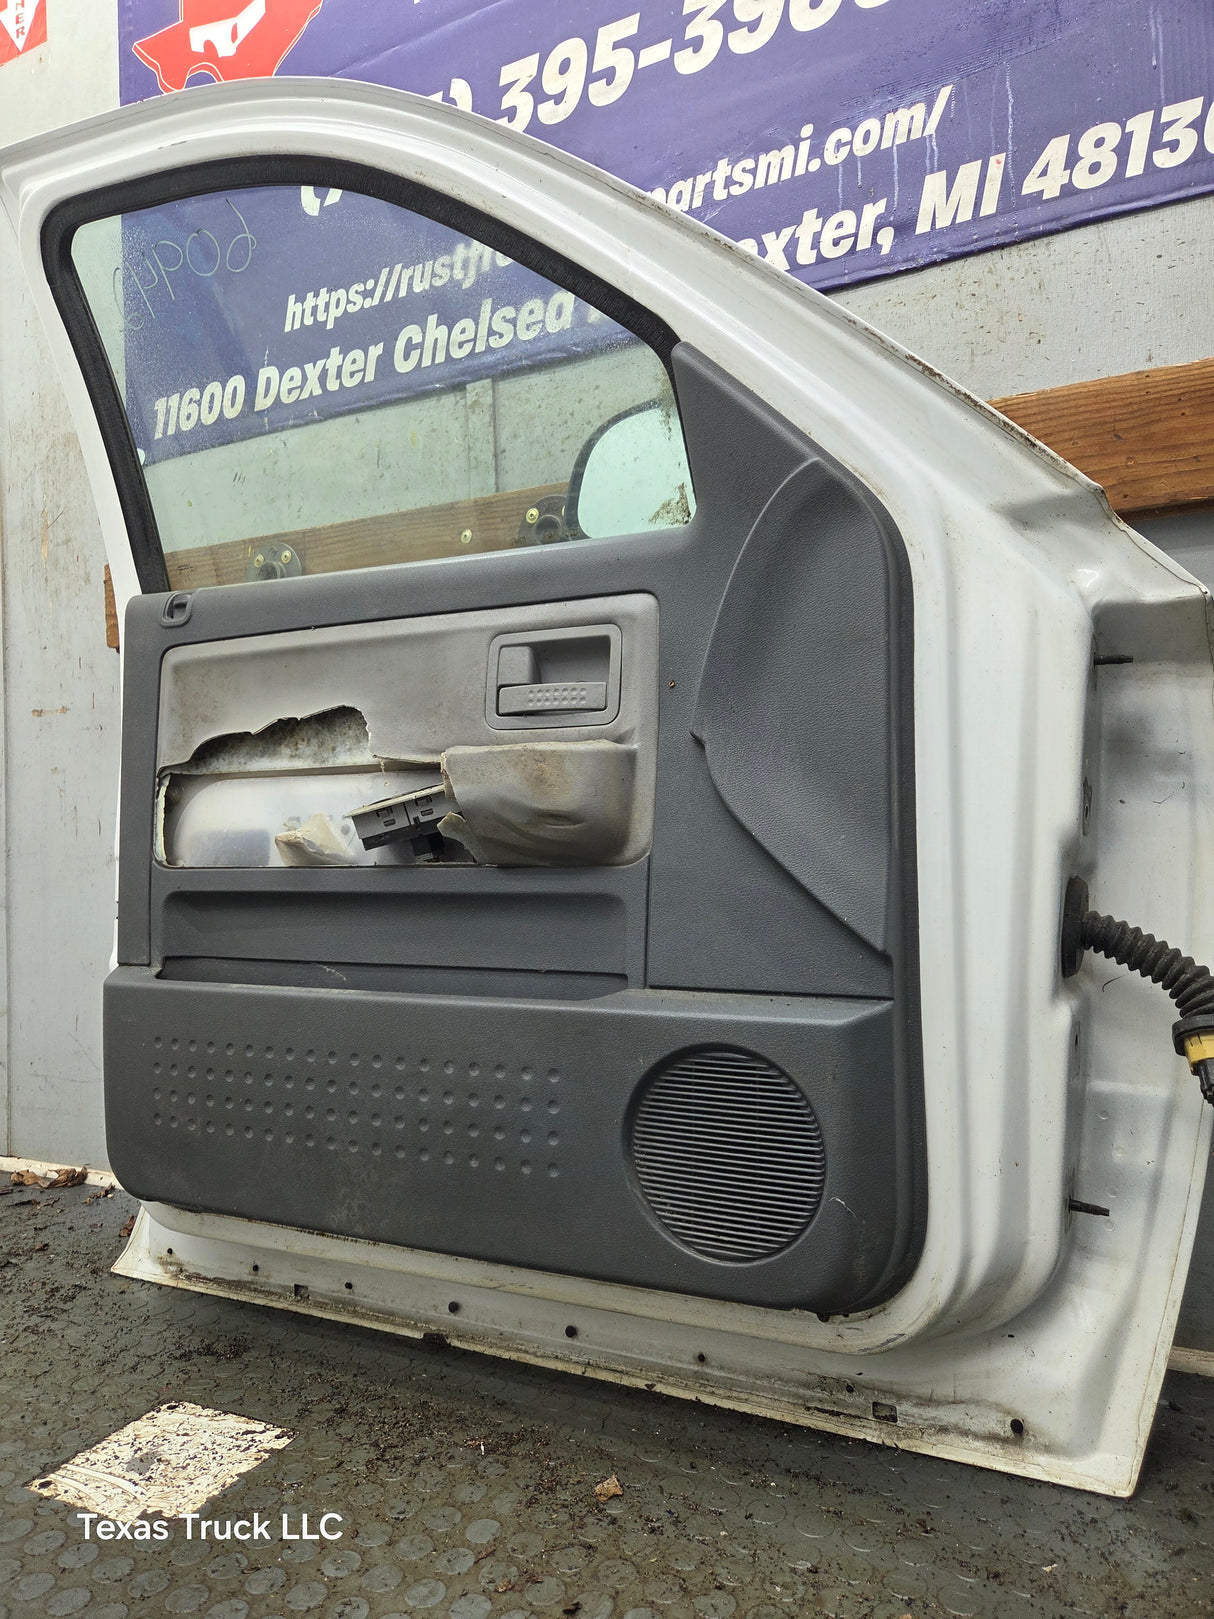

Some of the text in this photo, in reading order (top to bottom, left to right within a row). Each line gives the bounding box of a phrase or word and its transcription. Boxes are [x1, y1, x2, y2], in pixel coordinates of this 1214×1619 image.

[494, 0, 890, 134] 395-39
[154, 374, 246, 440] 11600
[254, 340, 384, 412] Dexter
[393, 290, 575, 374] Chelsea
[915, 152, 1006, 235] MI
[1021, 96, 1214, 200] 4813
